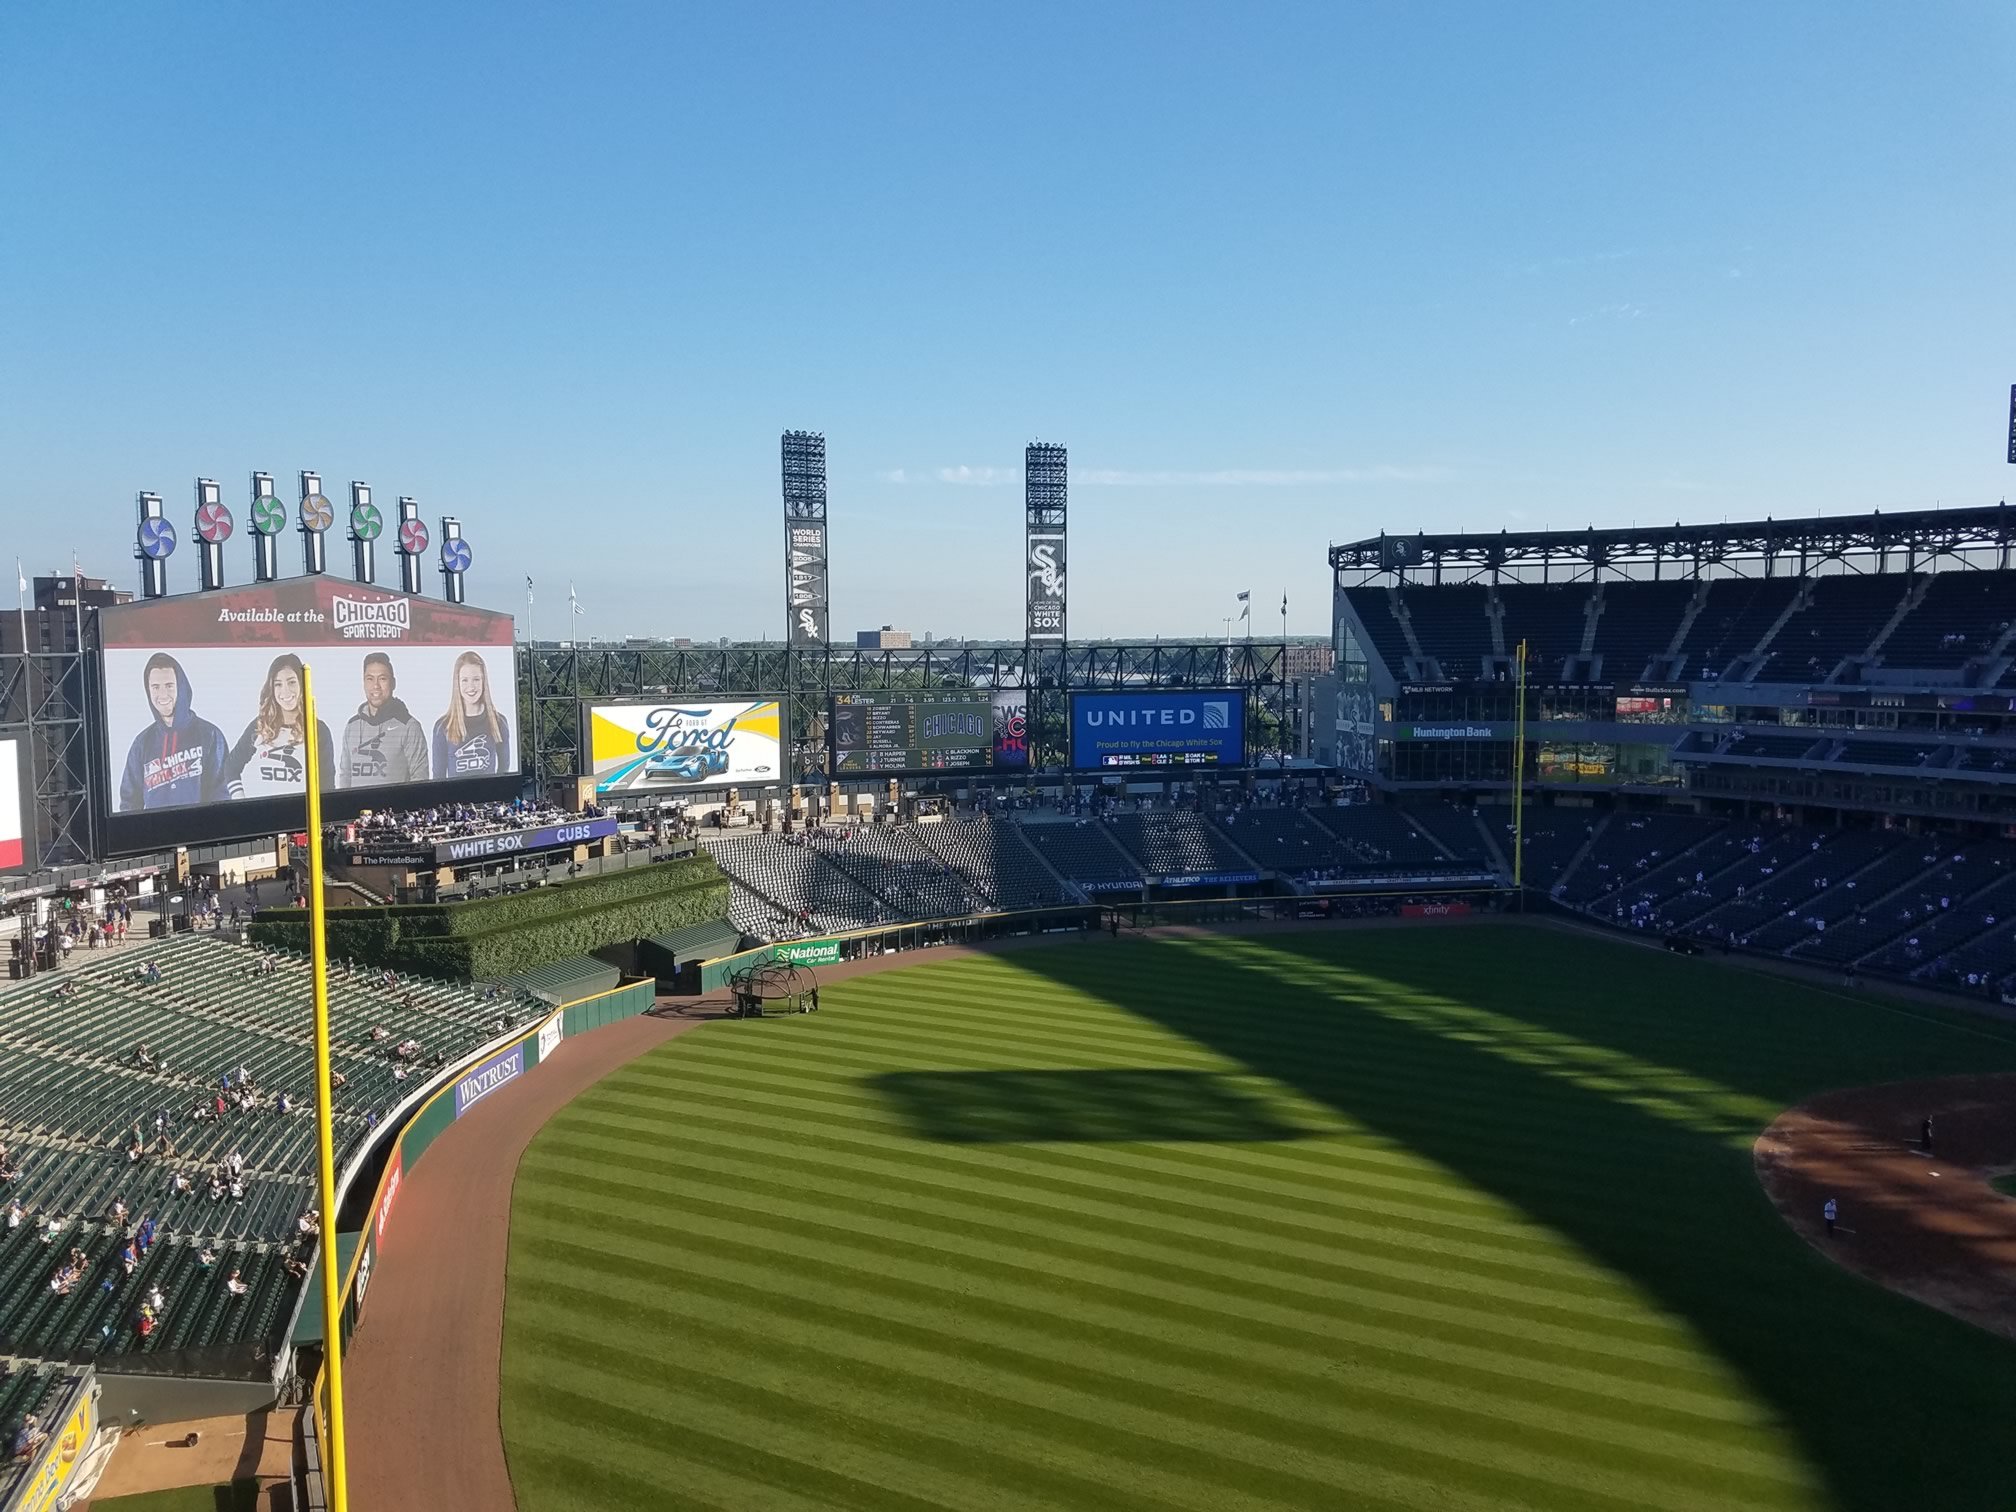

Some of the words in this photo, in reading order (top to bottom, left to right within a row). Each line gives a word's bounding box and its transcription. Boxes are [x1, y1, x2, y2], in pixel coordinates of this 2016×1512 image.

[218, 608, 284, 623] Available
[287, 610, 301, 623] at
[304, 609, 325, 623] the
[336, 600, 407, 624] CHICAGO
[1034, 618, 1060, 628] SOX
[344, 624, 375, 638] SPORTS
[377, 624, 401, 638] DEPOT
[837, 695, 851, 704] 34
[1087, 710, 1195, 726] UNITED
[636, 708, 737, 752] Ford
[924, 713, 983, 739] CHICAGO
[1414, 727, 1465, 739] Huntington
[1466, 727, 1491, 737] Bank
[1130, 740, 1139, 749] fly
[1156, 740, 1184, 749] Chicago
[162, 746, 203, 768] CHICAGO
[455, 756, 490, 772] SOX
[260, 767, 302, 782] SOX
[352, 763, 387, 777] SOX
[557, 825, 590, 842] CUBS
[450, 840, 494, 859] WHITE
[497, 835, 523, 853] SOX
[363, 856, 377, 864] The
[378, 856, 424, 864] PrivateBank
[1098, 881, 1143, 890] HYUNDAI
[1163, 876, 1200, 884] ATHLETICO
[1424, 906, 1450, 915] xfinity
[790, 943, 837, 960] National
[459, 1054, 519, 1104] WINTRUST
